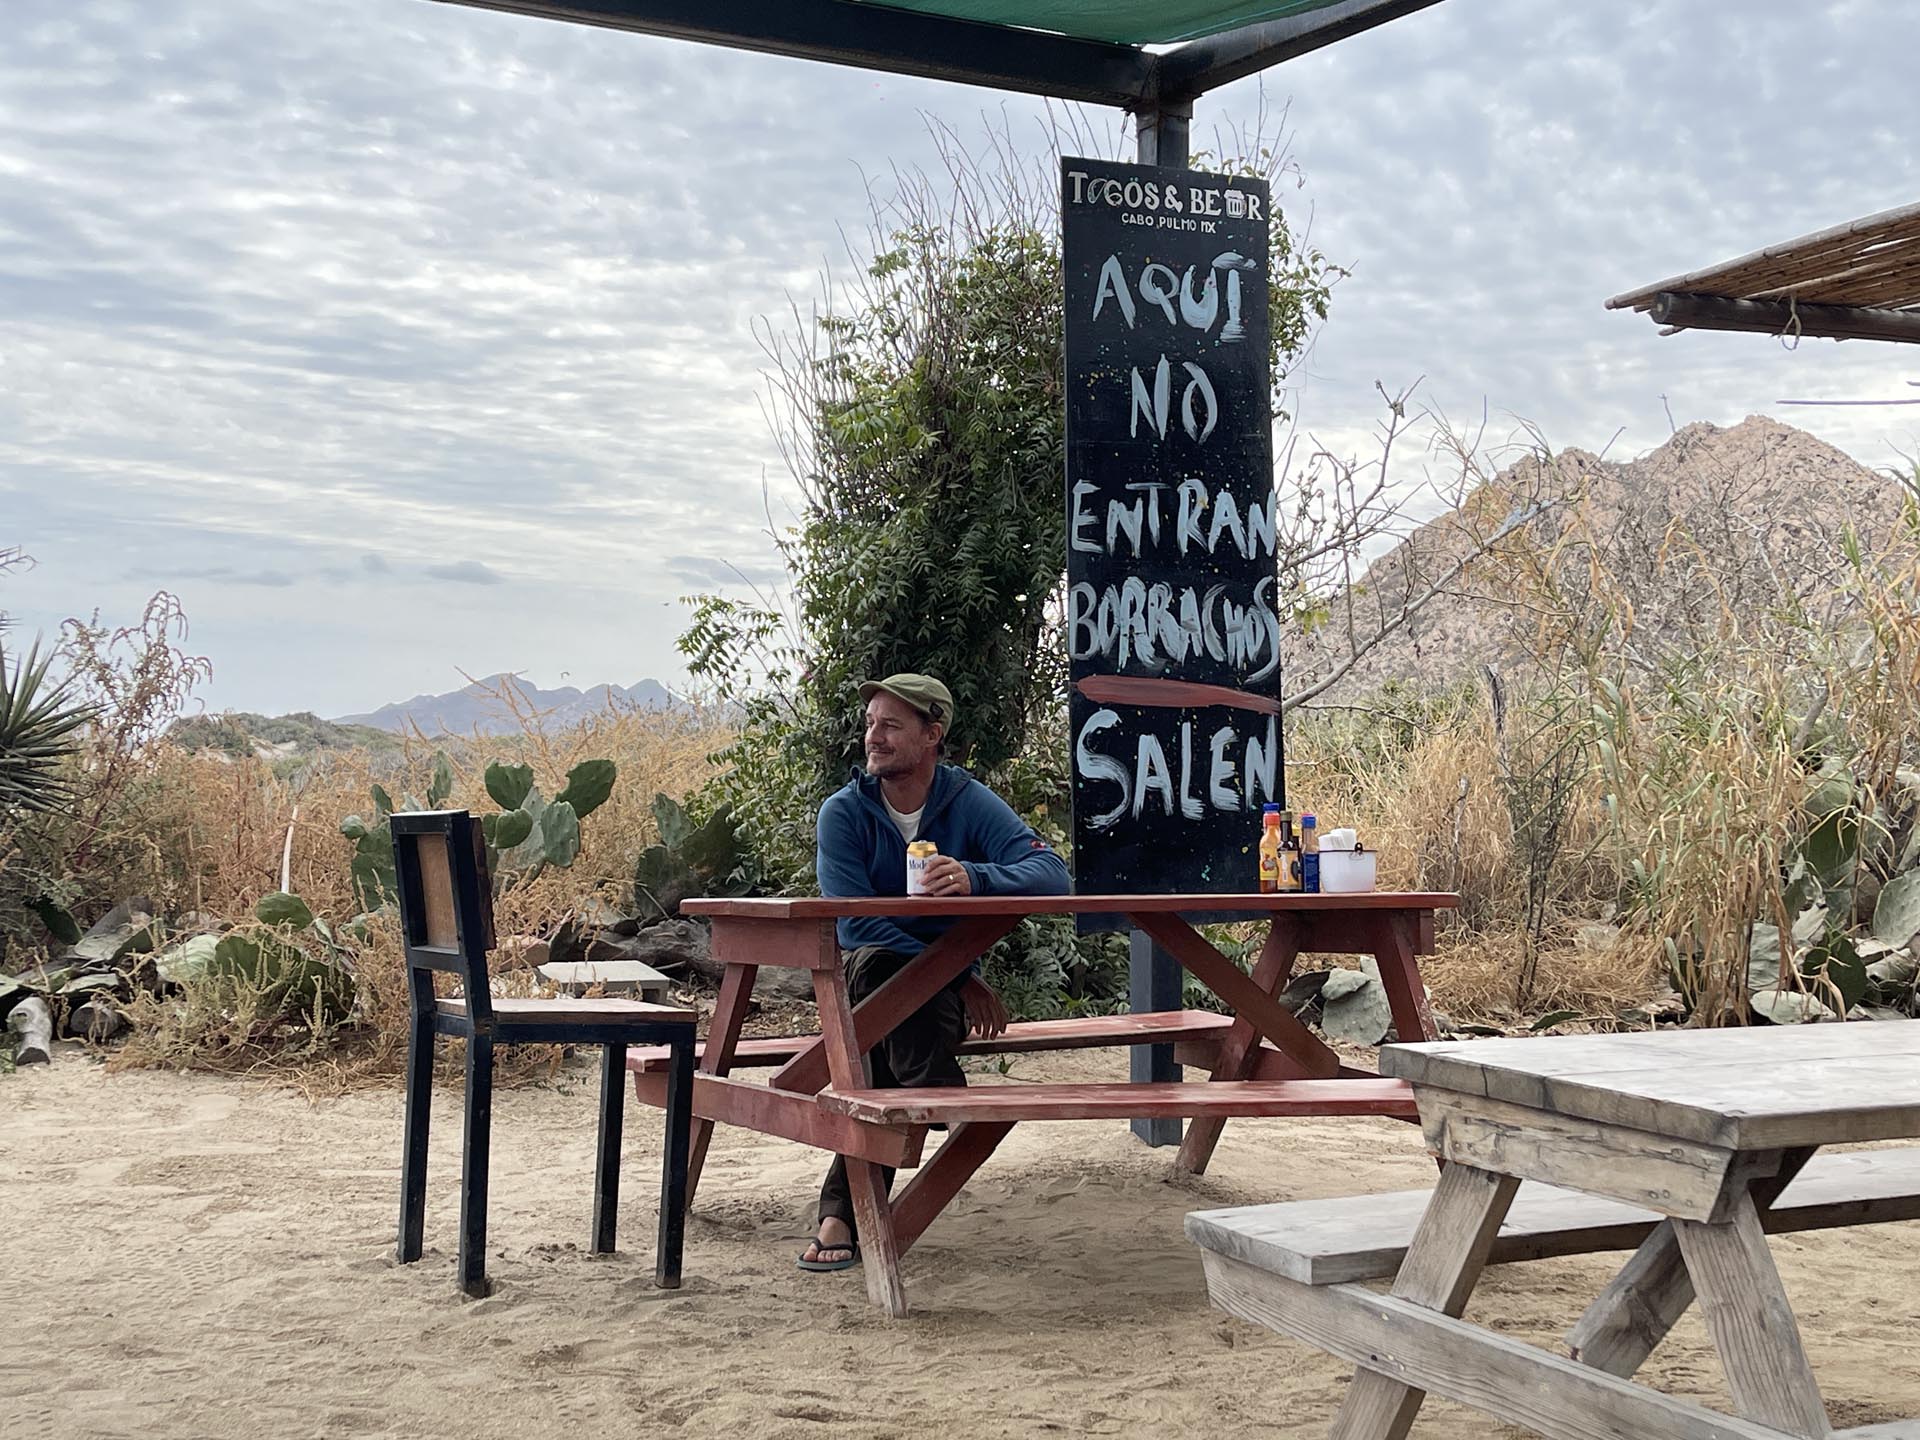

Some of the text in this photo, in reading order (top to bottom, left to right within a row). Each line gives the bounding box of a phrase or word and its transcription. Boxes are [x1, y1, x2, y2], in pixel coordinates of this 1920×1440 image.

[1121, 212, 1154, 226] CABO
[1159, 216, 1197, 231] PULMO
[1164, 184, 1184, 213] &
[1130, 353, 1218, 442] NO
[1071, 478, 1278, 560] ENTRAN
[1069, 575, 1279, 684] BORRACHOS
[1076, 708, 1278, 834] SALEN
